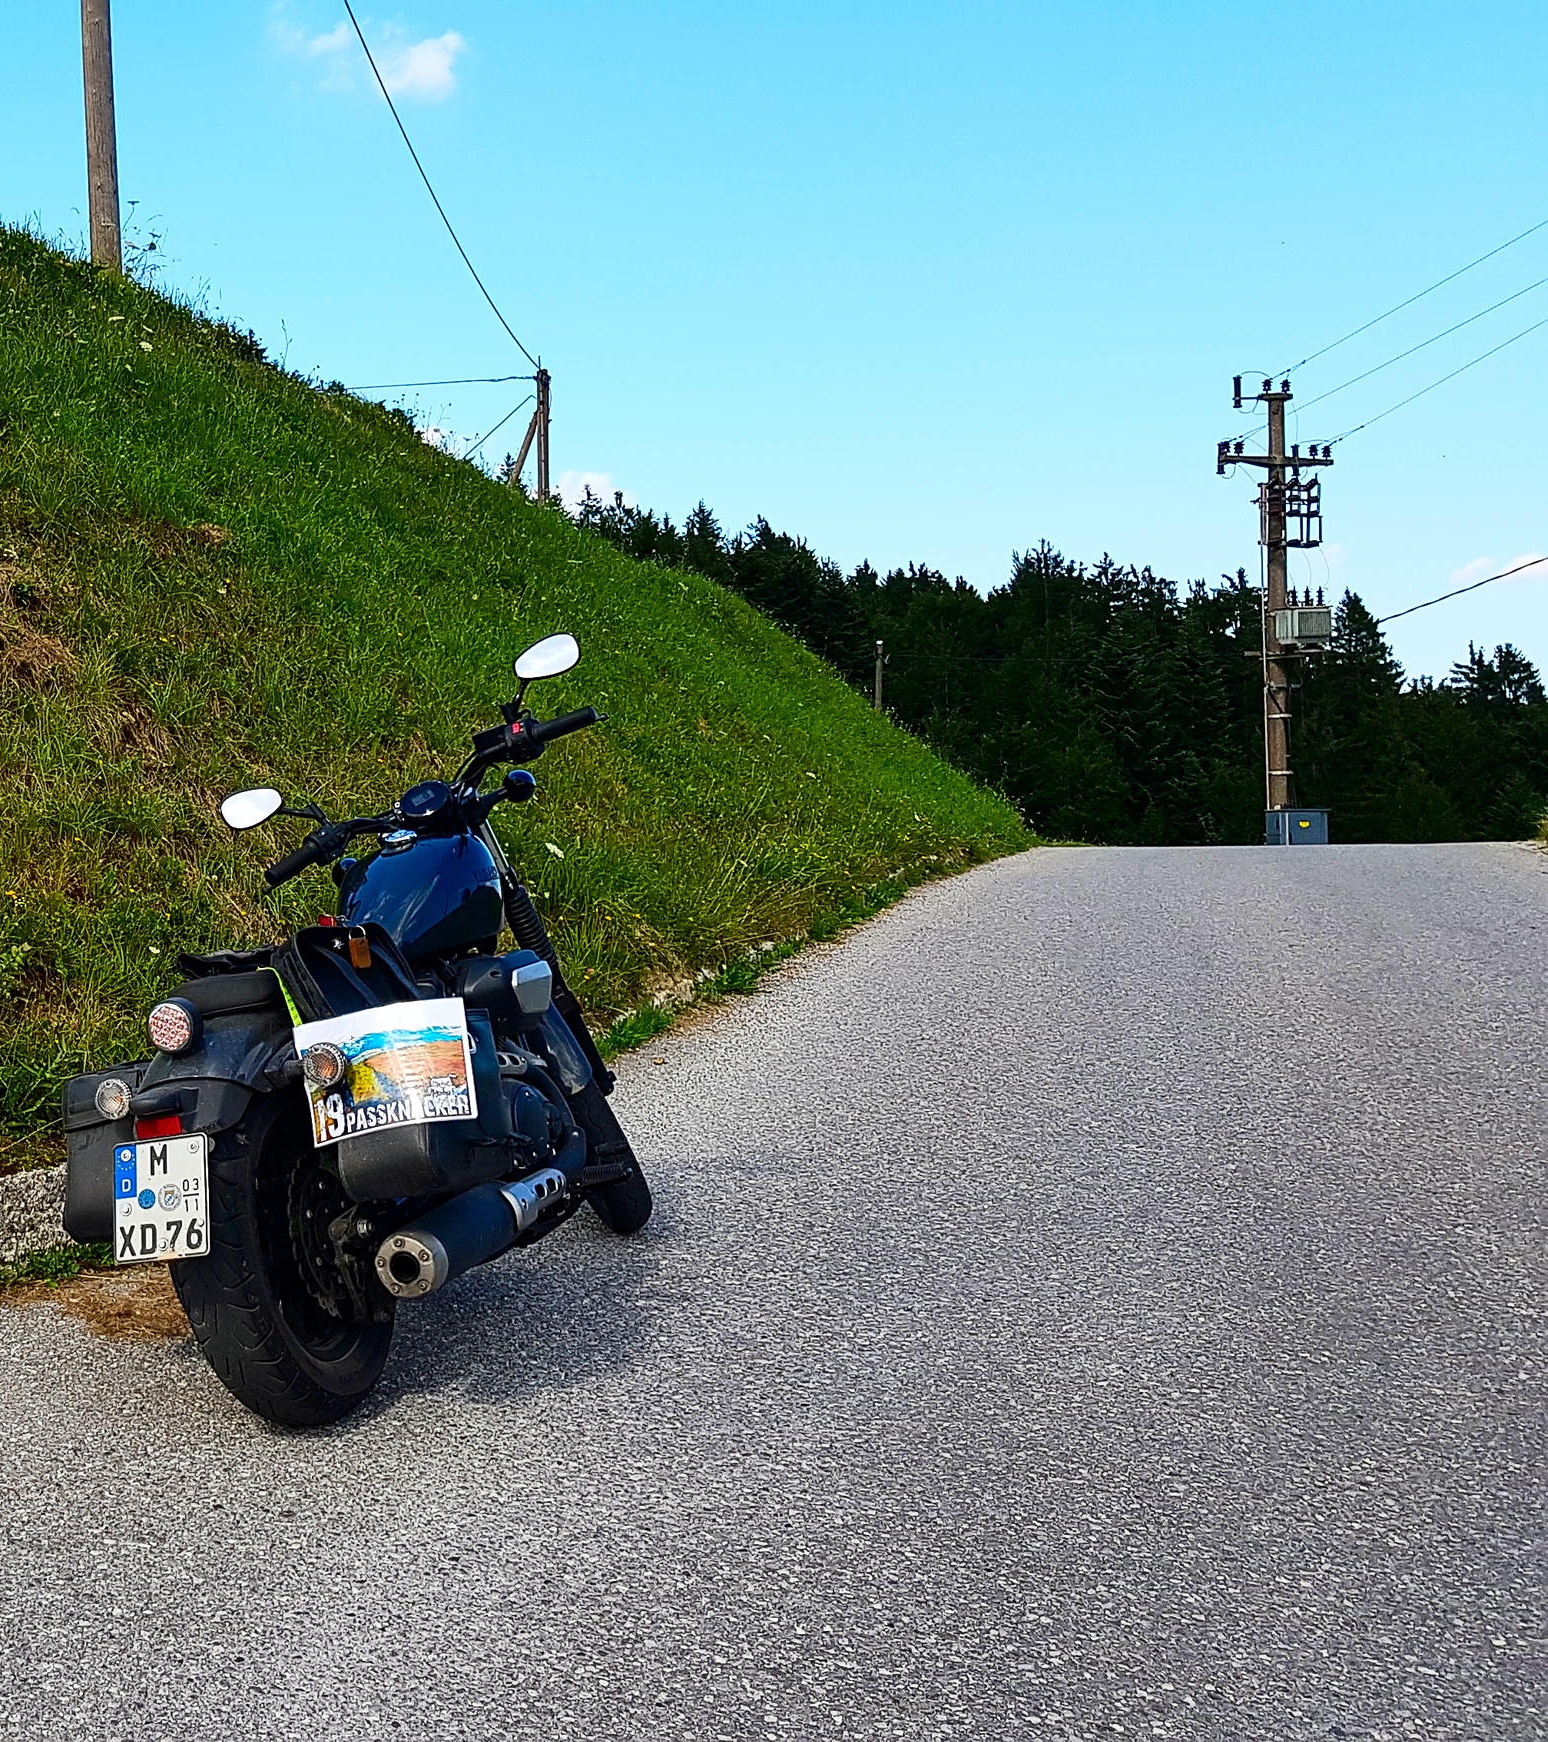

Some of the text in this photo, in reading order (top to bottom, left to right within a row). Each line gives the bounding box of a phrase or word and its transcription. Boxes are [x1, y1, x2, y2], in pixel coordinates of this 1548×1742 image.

[314, 1092, 470, 1142] 19 PASSKNCKER
[149, 1143, 168, 1176] M
[121, 1178, 132, 1193] D
[182, 1177, 200, 1192] 03
[184, 1198, 199, 1213] 11
[119, 1217, 203, 1258] XD 76
